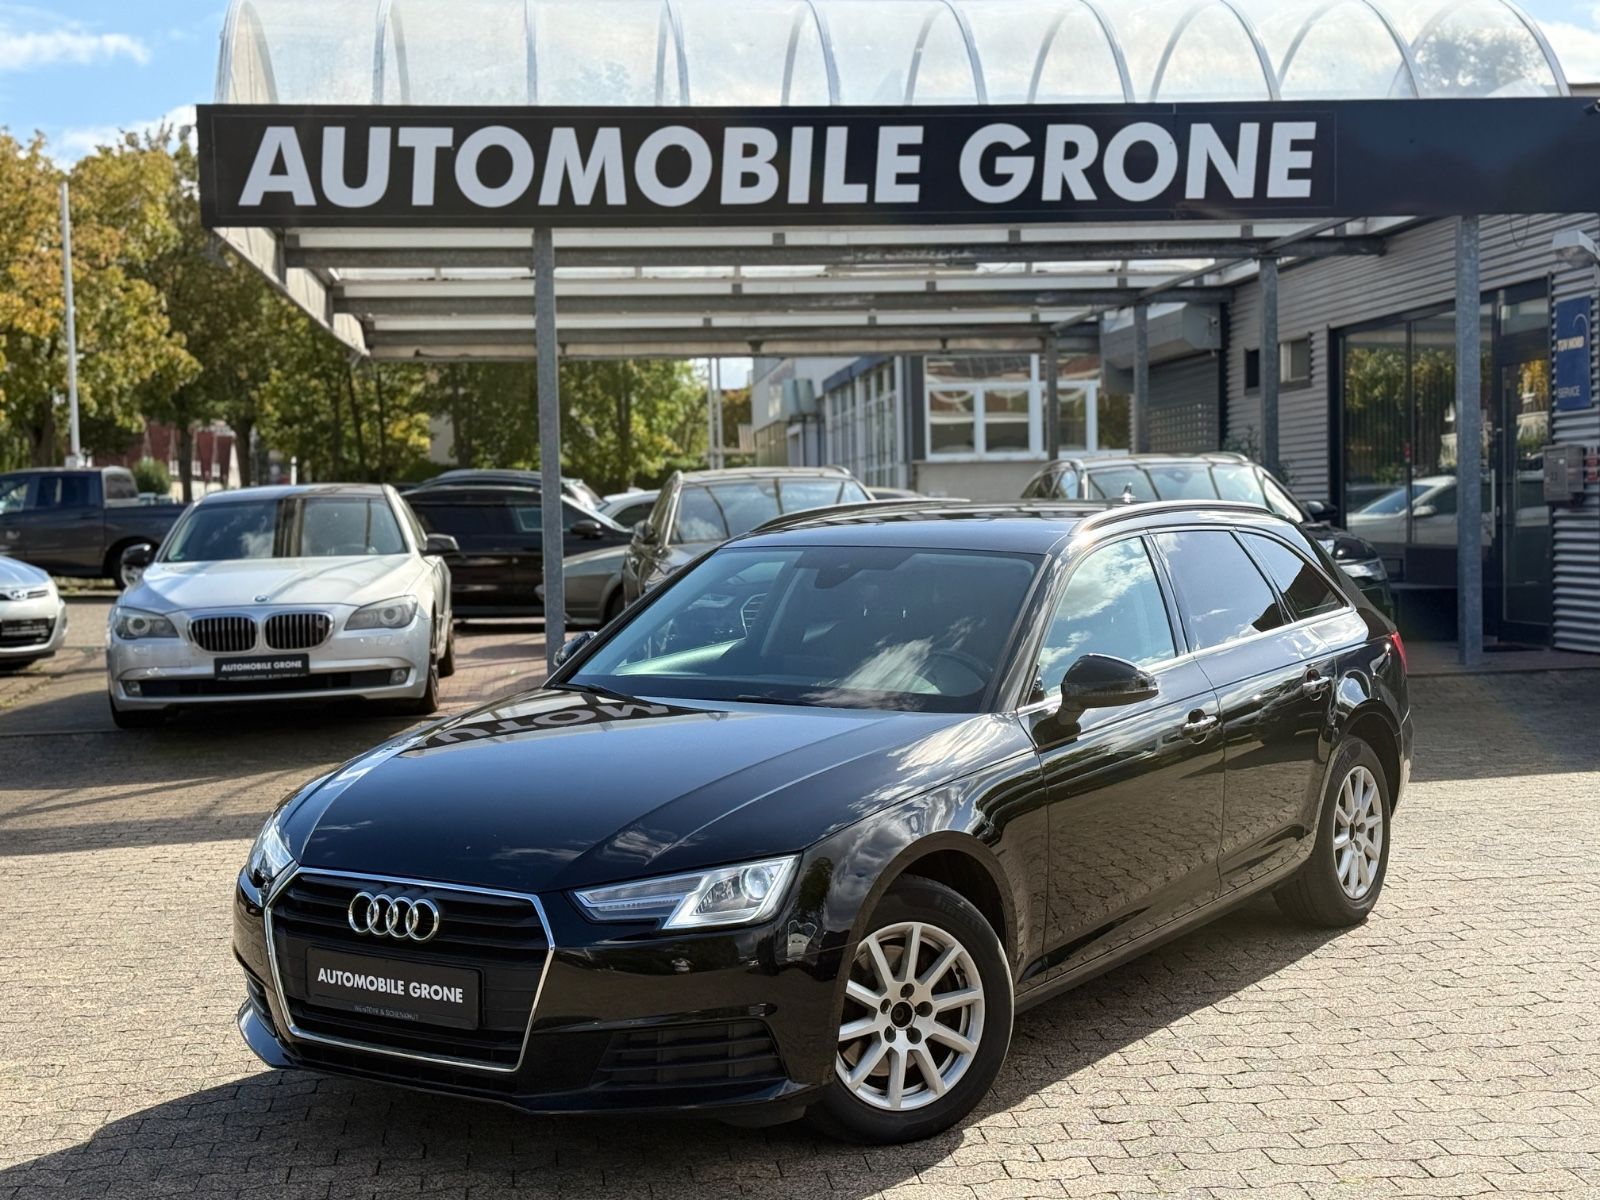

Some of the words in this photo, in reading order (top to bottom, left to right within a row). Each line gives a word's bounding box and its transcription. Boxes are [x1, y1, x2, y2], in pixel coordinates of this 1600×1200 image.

[238, 125, 924, 208] AUTOMOBILE
[959, 121, 1317, 203] GRONE
[221, 662, 272, 672] AUTOMOBILE
[273, 660, 303, 669] GRONE
[317, 967, 405, 996] AUTOMOBILE
[408, 981, 464, 1004] GRONE
